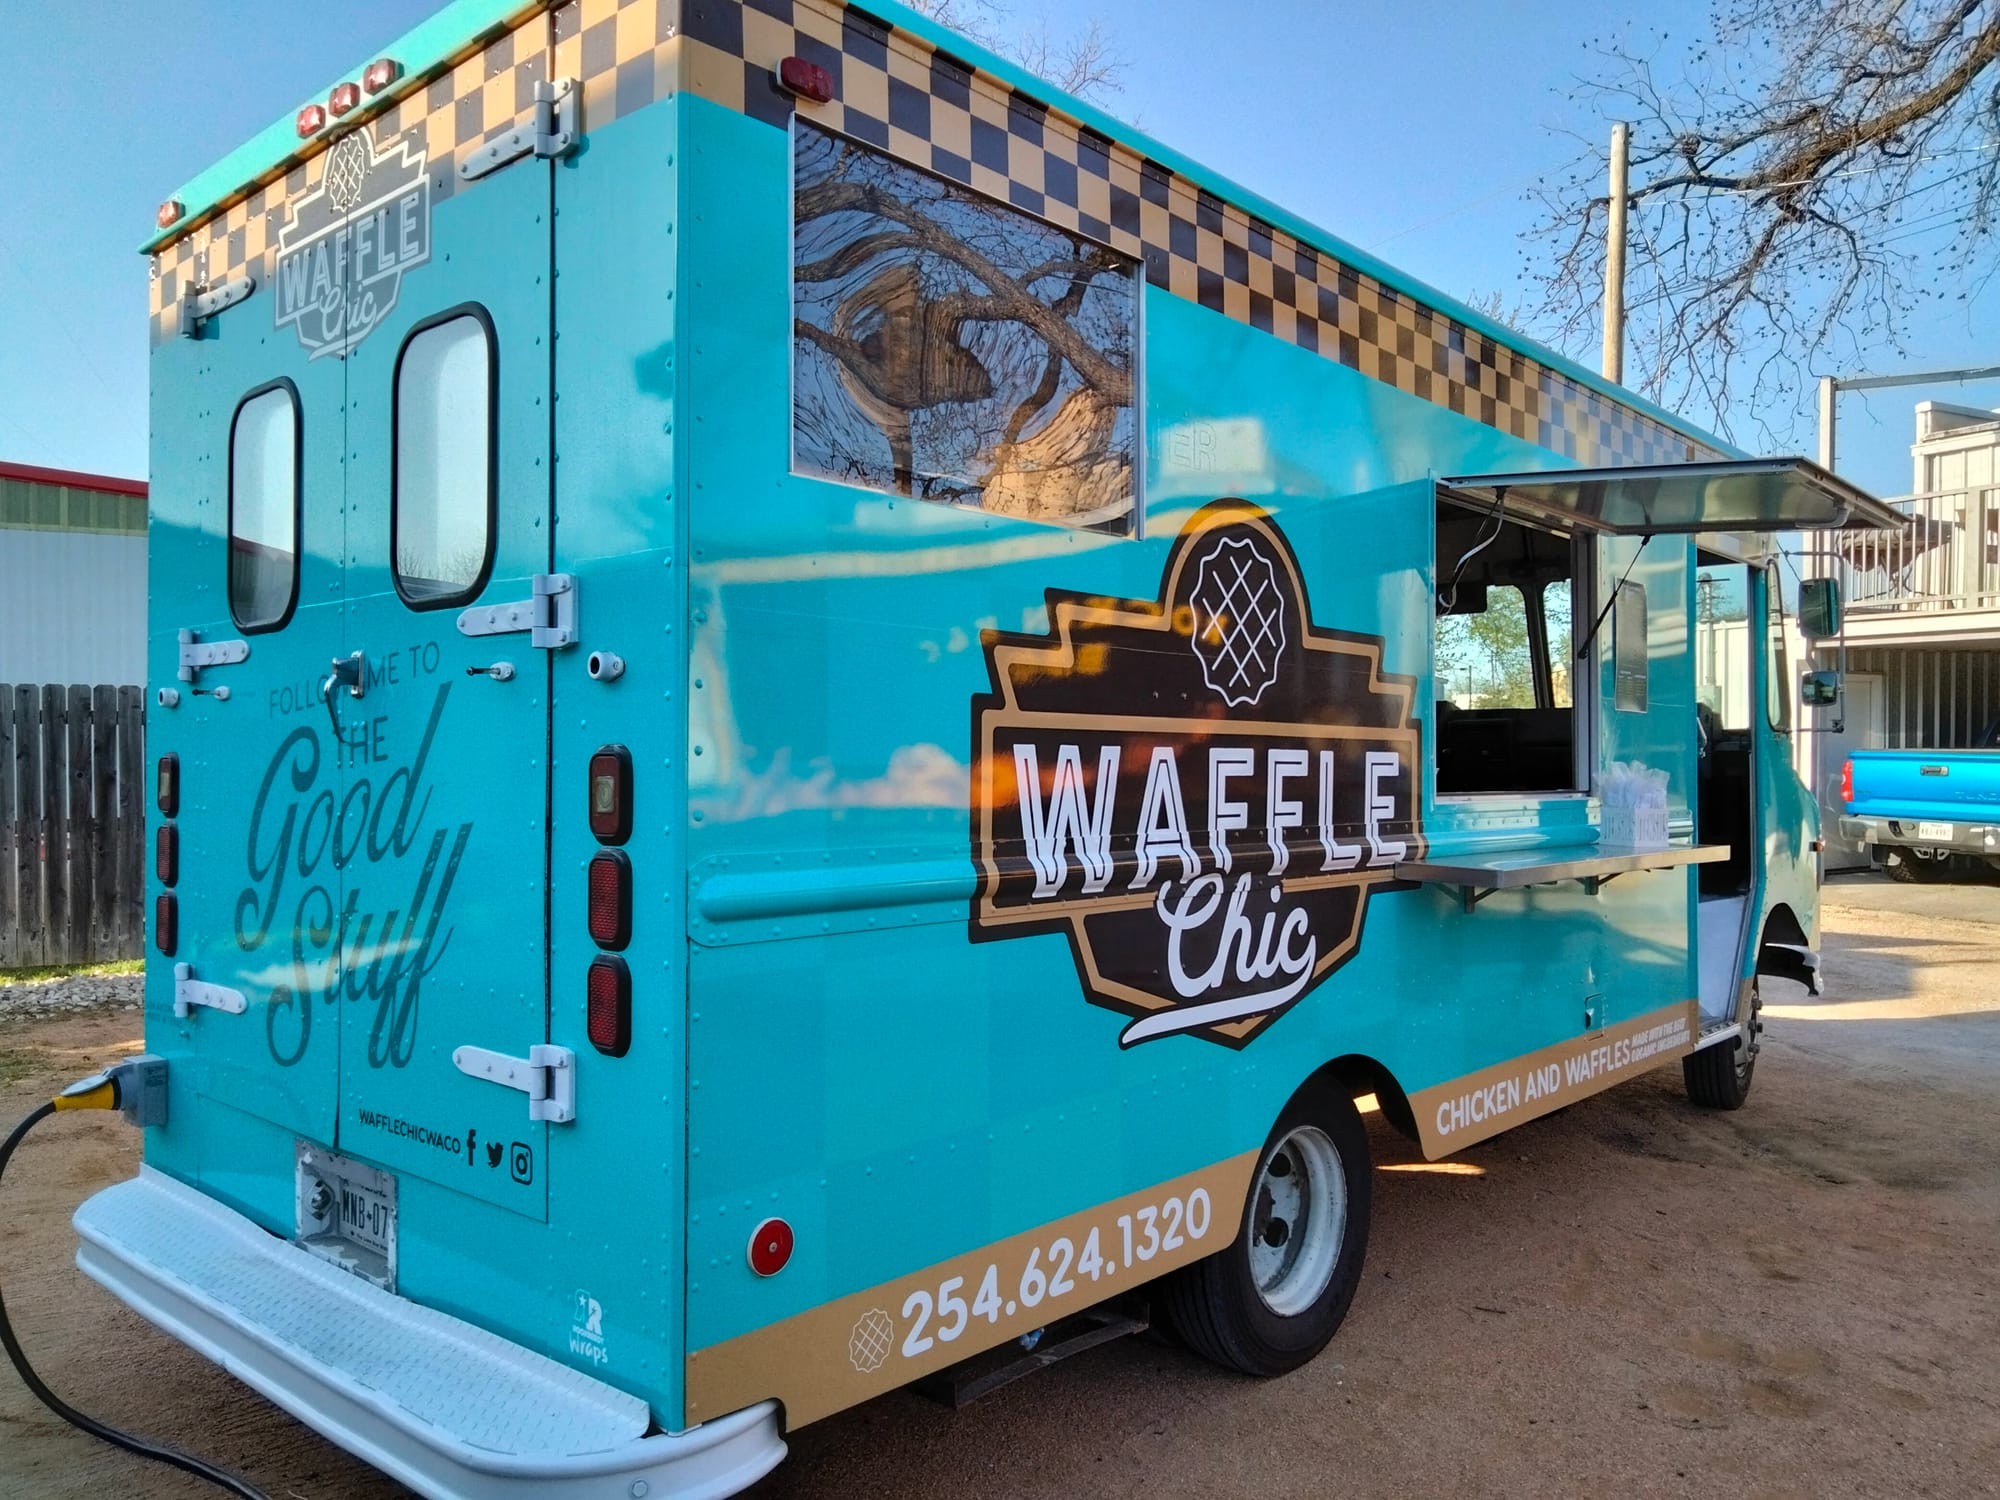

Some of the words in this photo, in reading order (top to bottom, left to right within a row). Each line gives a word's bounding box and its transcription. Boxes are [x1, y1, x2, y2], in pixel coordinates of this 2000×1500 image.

[283, 191, 419, 314] WAFFLE
[269, 672, 352, 720] FOLLO
[368, 652, 400, 691] ME
[409, 641, 440, 679] TO
[332, 715, 389, 768] THE
[234, 680, 454, 952] Good
[1013, 743, 1407, 899] WAFFLE
[266, 821, 475, 1069] Stuff
[1118, 872, 1317, 1044] Chic
[359, 1108, 461, 1154] WAFFLECHICWACO
[1436, 1077, 1520, 1136] CHICKEN
[1525, 1063, 1560, 1103] AND
[1565, 1039, 1631, 1086] WAFFLES
[902, 1187, 1212, 1358] 254.624.1320
